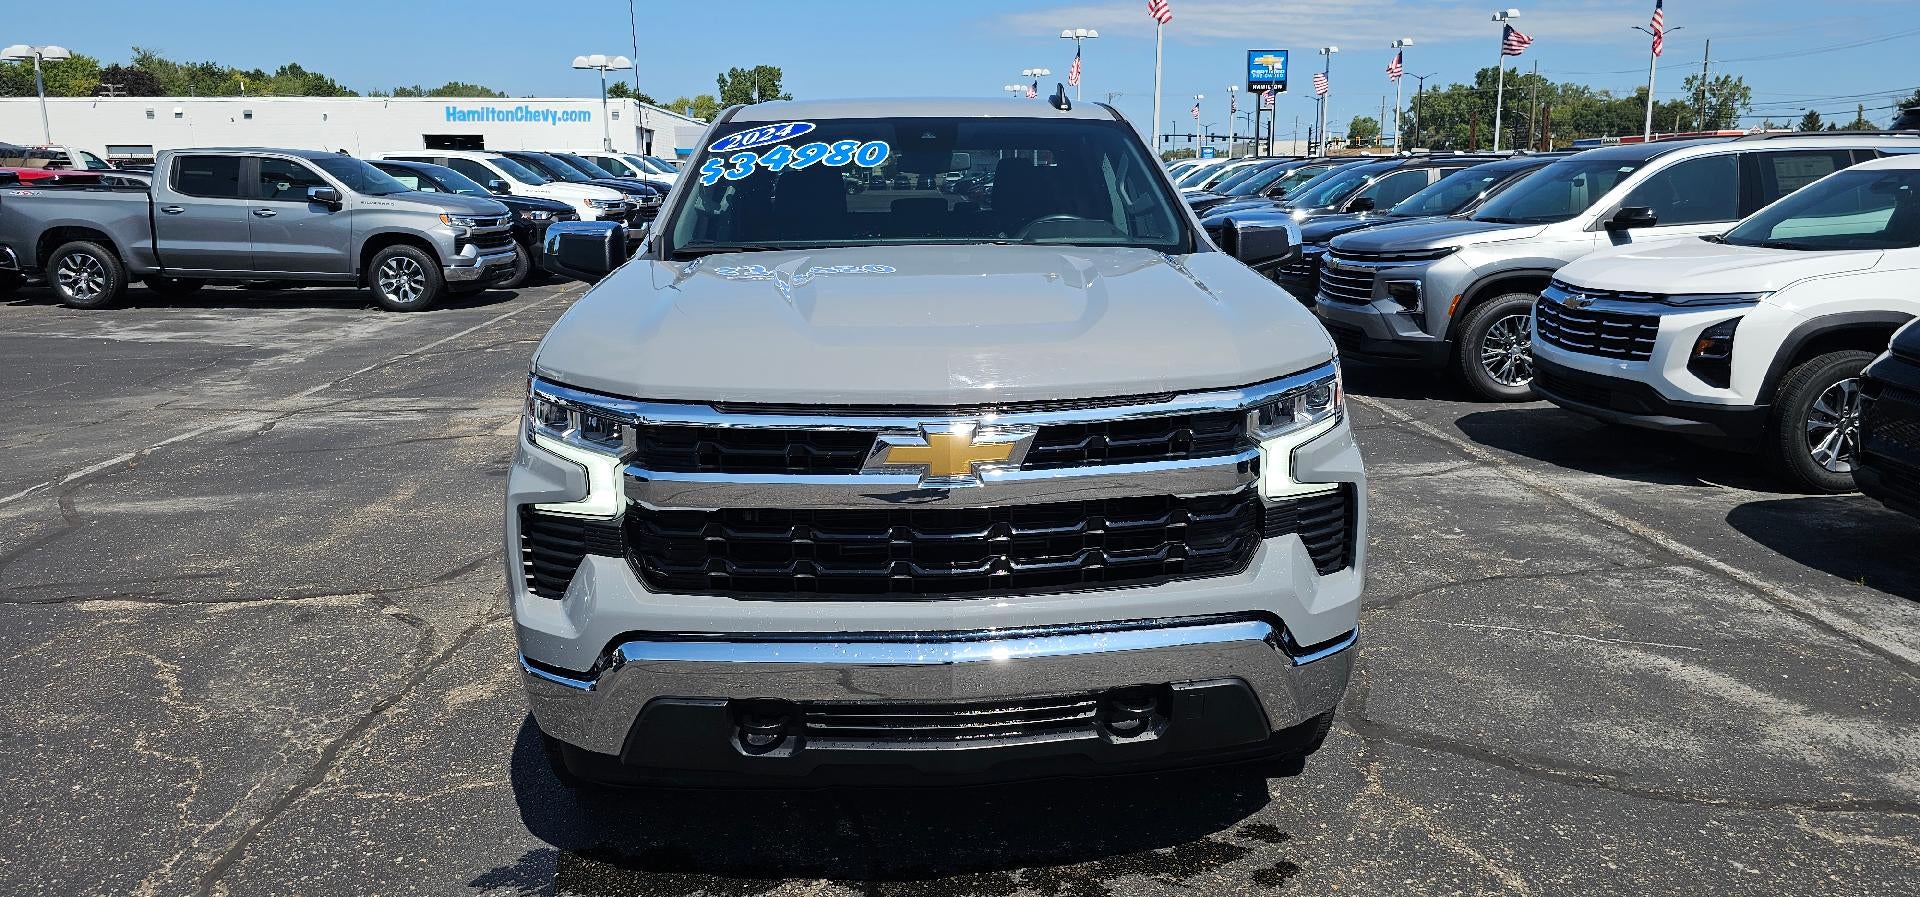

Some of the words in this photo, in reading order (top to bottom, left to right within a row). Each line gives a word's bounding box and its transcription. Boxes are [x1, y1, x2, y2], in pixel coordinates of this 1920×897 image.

[445, 106, 591, 126] HamiltonChevy.com
[723, 123, 796, 151] 2024
[700, 140, 890, 186] $34980
